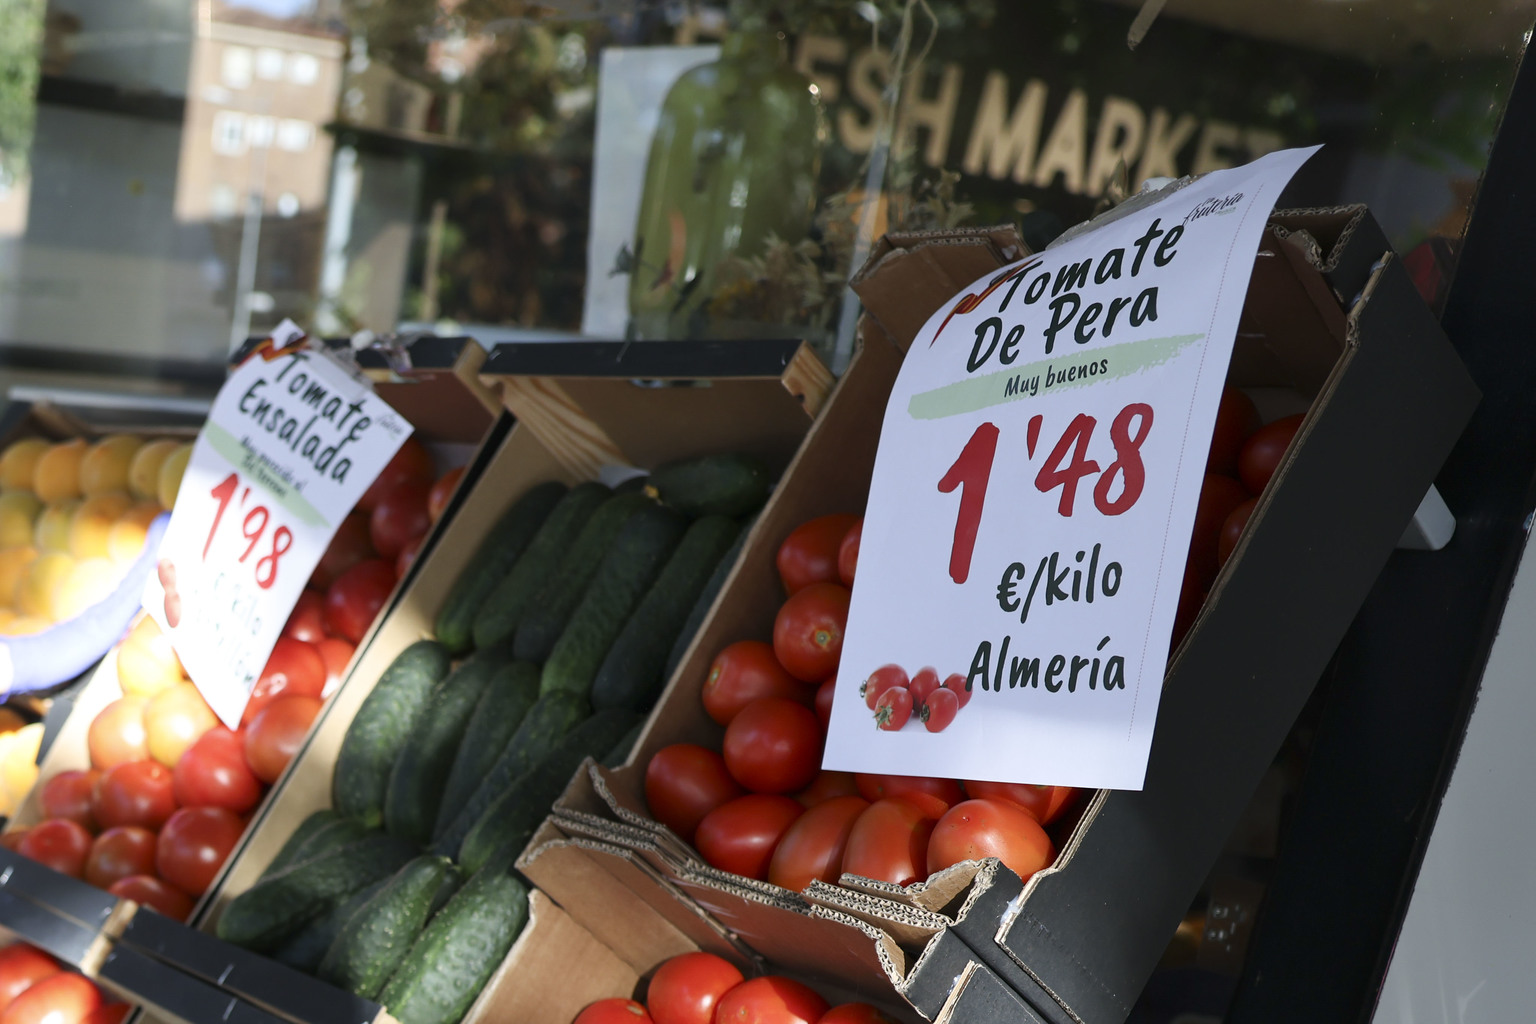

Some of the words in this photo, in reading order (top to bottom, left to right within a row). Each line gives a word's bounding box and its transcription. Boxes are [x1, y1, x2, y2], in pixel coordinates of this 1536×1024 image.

[998, 218, 1184, 313] Tomate
[966, 317, 1025, 373] De
[1043, 286, 1159, 354] Pera
[275, 352, 371, 441] Tomate
[1004, 374, 1041, 398] Muy
[1045, 359, 1109, 388] buenos
[238, 379, 352, 486] Ensalada
[202, 472, 293, 590] 1'98
[937, 403, 1154, 585] 1'48
[996, 543, 1123, 624] €/kilo
[965, 635, 1126, 693] Almería
